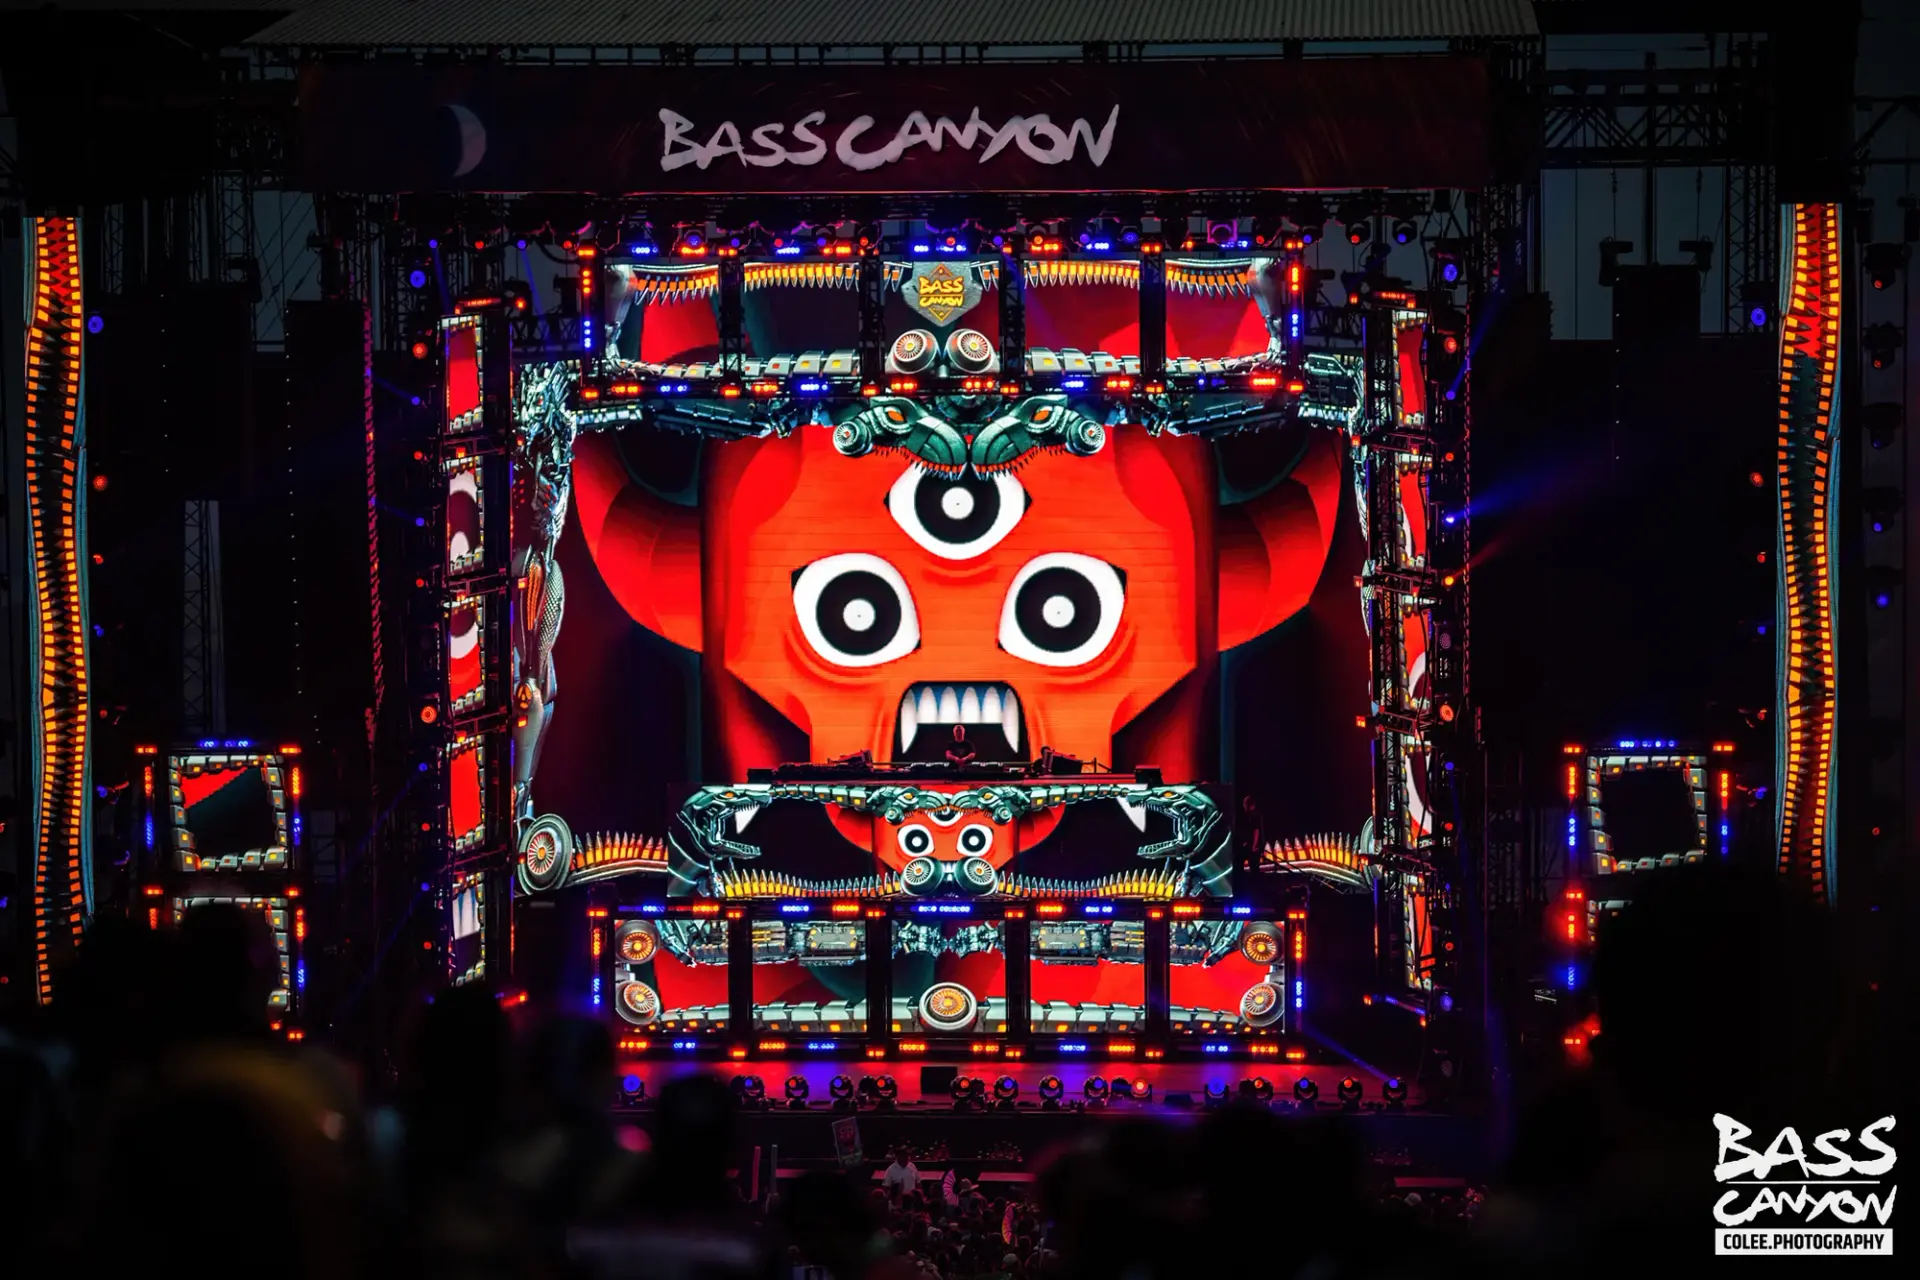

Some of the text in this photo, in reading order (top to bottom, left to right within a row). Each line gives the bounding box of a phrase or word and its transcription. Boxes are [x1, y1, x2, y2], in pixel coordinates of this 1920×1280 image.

[659, 104, 1119, 171] BASS CANYON
[919, 276, 963, 294] BASS
[919, 295, 963, 307] CANYON
